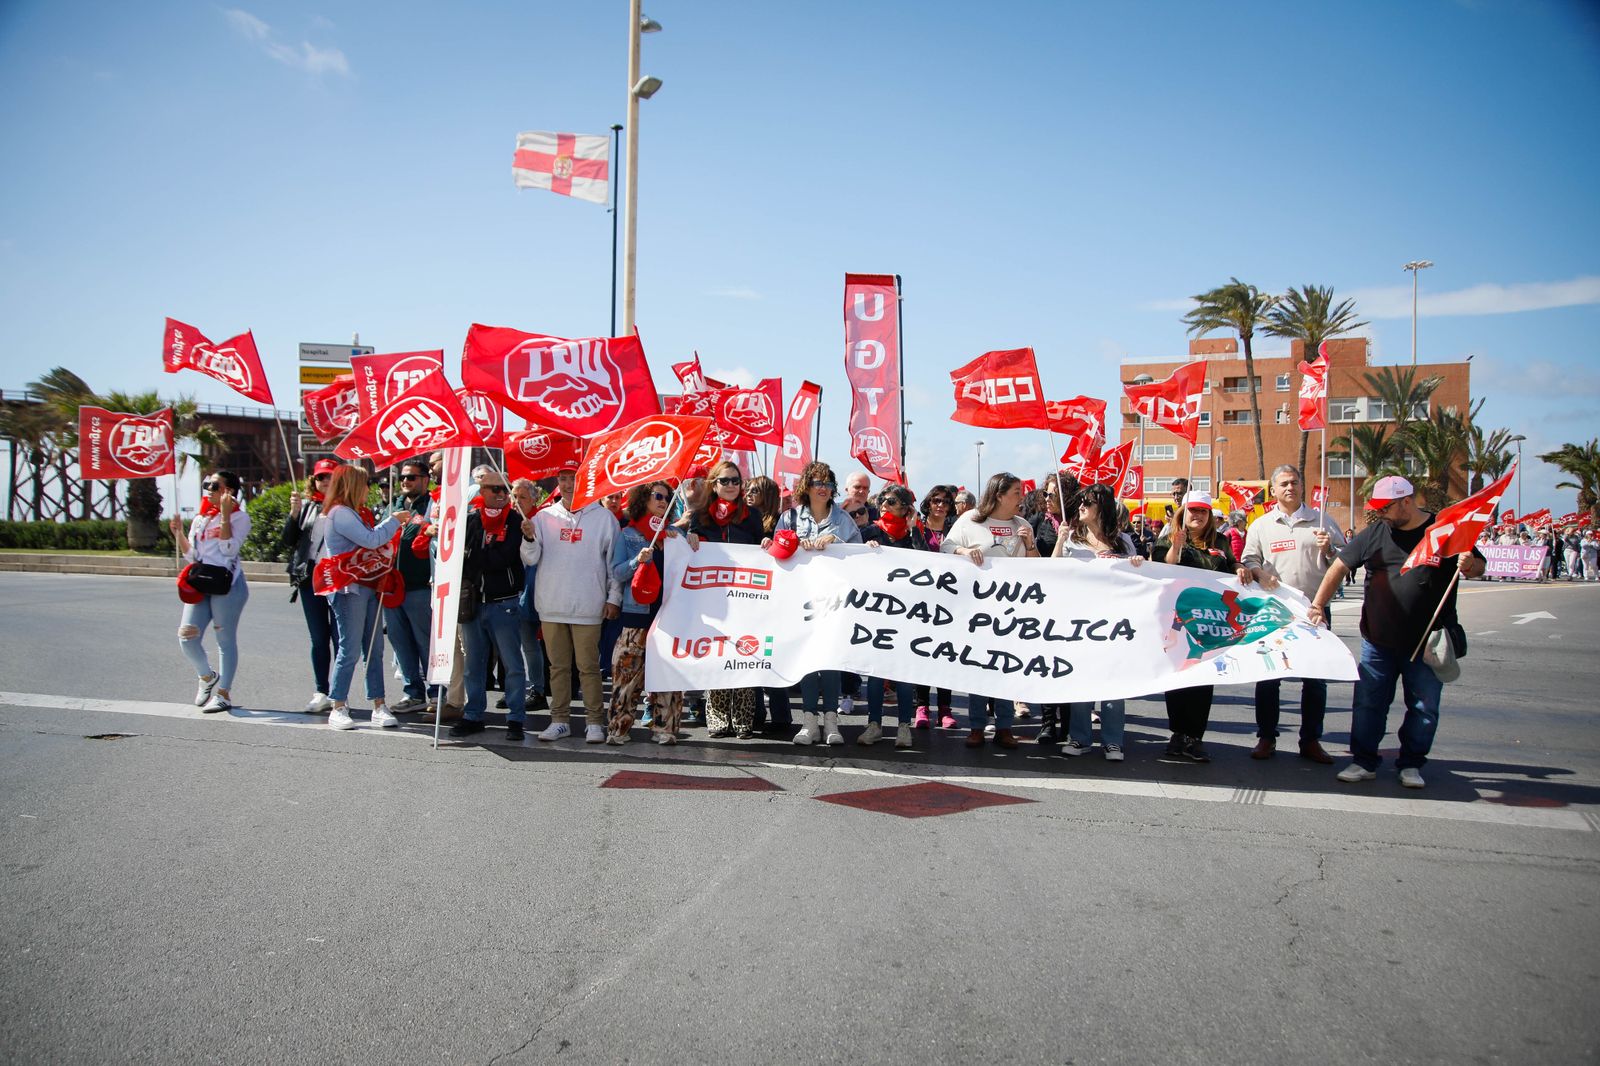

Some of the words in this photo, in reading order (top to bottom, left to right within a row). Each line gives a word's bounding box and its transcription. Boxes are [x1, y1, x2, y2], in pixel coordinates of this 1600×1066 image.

[1523, 550, 1541, 561] LAS
[1486, 561, 1520, 573] UJERES
[685, 570, 751, 585] CCOO
[887, 568, 958, 595] POR
[973, 580, 1046, 604] UNA
[726, 590, 769, 600] Almería
[968, 607, 1136, 642] PÚBLICA
[672, 635, 731, 659] UGT
[850, 622, 898, 650] DE
[910, 636, 1074, 678] CALIDAD
[724, 659, 772, 670] Almería
